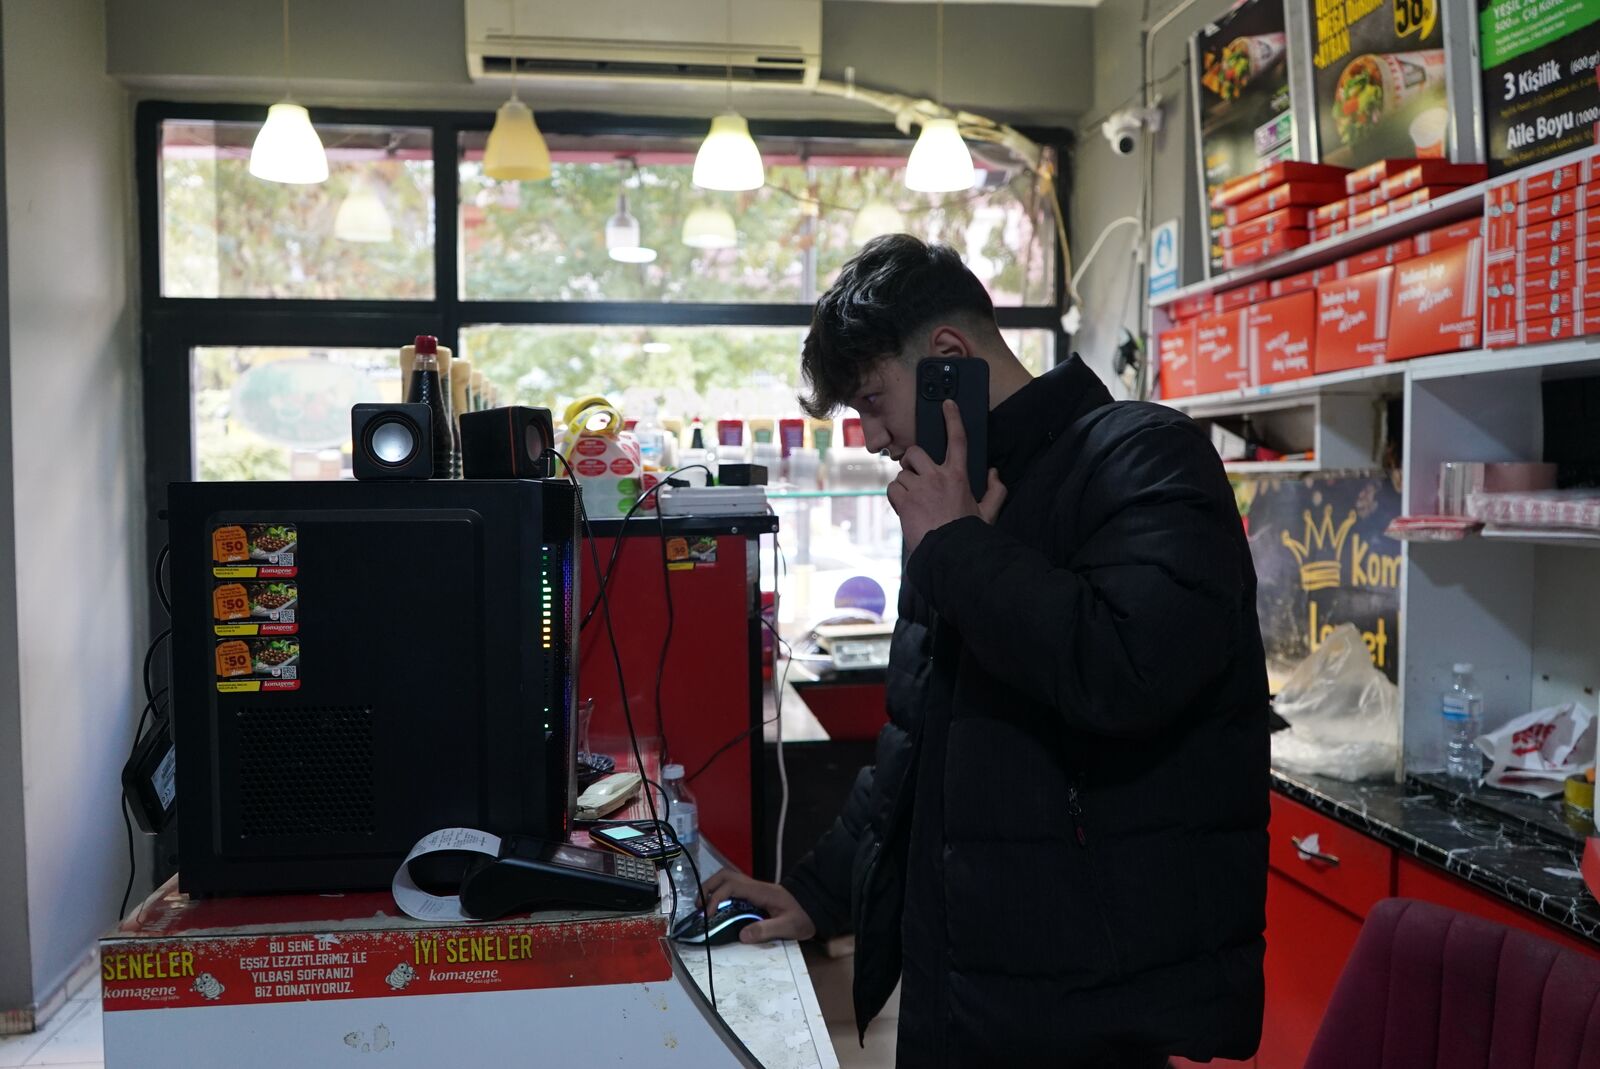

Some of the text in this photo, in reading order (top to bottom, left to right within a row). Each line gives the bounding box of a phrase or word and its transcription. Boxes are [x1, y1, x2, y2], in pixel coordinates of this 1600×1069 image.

[1503, 72, 1516, 100] 3
[1518, 60, 1561, 95] Kişilik
[1507, 122, 1535, 150] Aile
[1536, 111, 1574, 138] Boyu
[270, 939, 332, 953] BU SENE DE
[414, 933, 532, 964] İYİ SENELER
[103, 951, 194, 980] SENELER
[240, 951, 367, 971] EŞSİZ LEZZETLERİMİZ İLE
[252, 967, 353, 983] YILBAŞI SOFRANIZI
[429, 968, 498, 983] komagene
[103, 986, 177, 1000] komagene
[255, 982, 354, 998] BİZ DONATIYORUZ.
